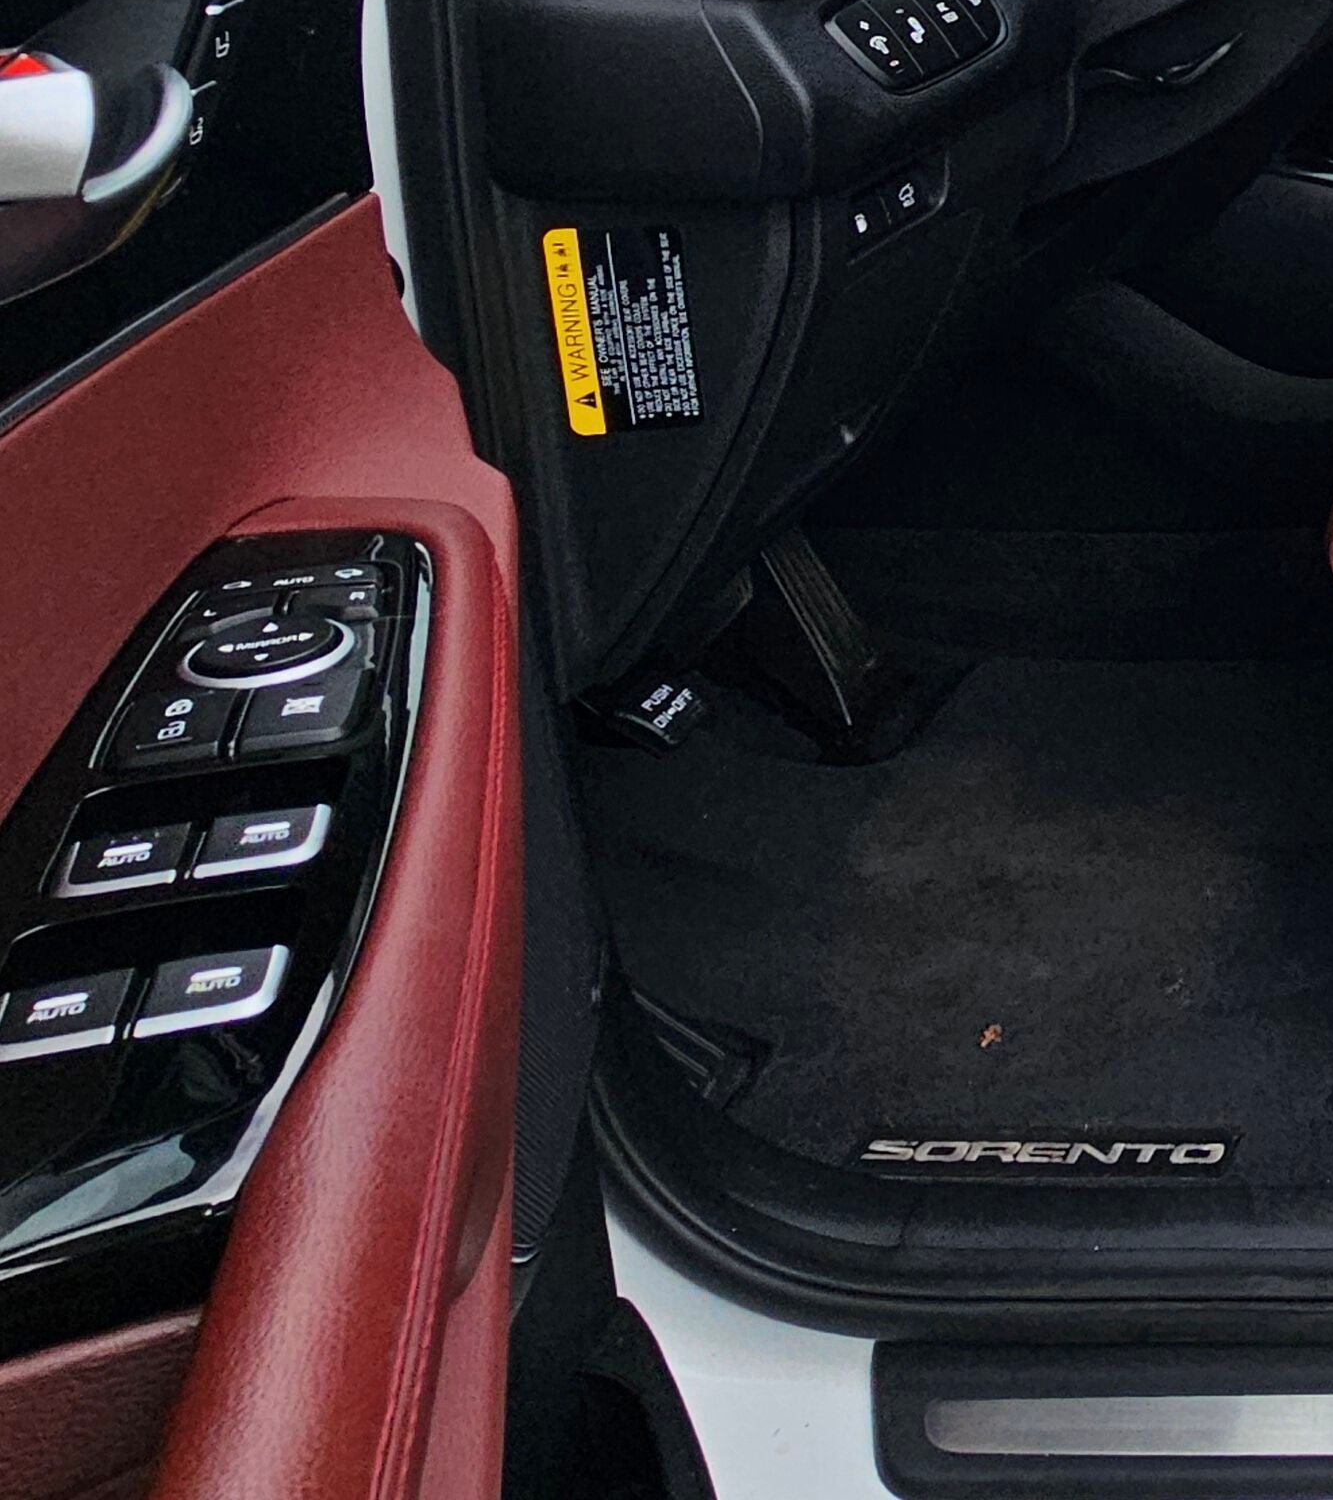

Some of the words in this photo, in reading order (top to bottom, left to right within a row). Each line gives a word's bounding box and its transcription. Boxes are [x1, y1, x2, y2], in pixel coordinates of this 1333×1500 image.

[586, 274, 602, 313] MANUAL
[557, 282, 589, 381] WARNING
[592, 319, 608, 362] OWNER'S
[599, 367, 611, 386] SEE
[272, 575, 315, 587] AUTO
[235, 633, 299, 652] MIRROR
[640, 683, 674, 712] PUSH
[239, 828, 291, 845] AUTO
[96, 850, 152, 869] AUTO
[185, 976, 242, 995] AUTO
[26, 1002, 87, 1025] AUTO
[860, 1138, 1226, 1166] SORENTO
